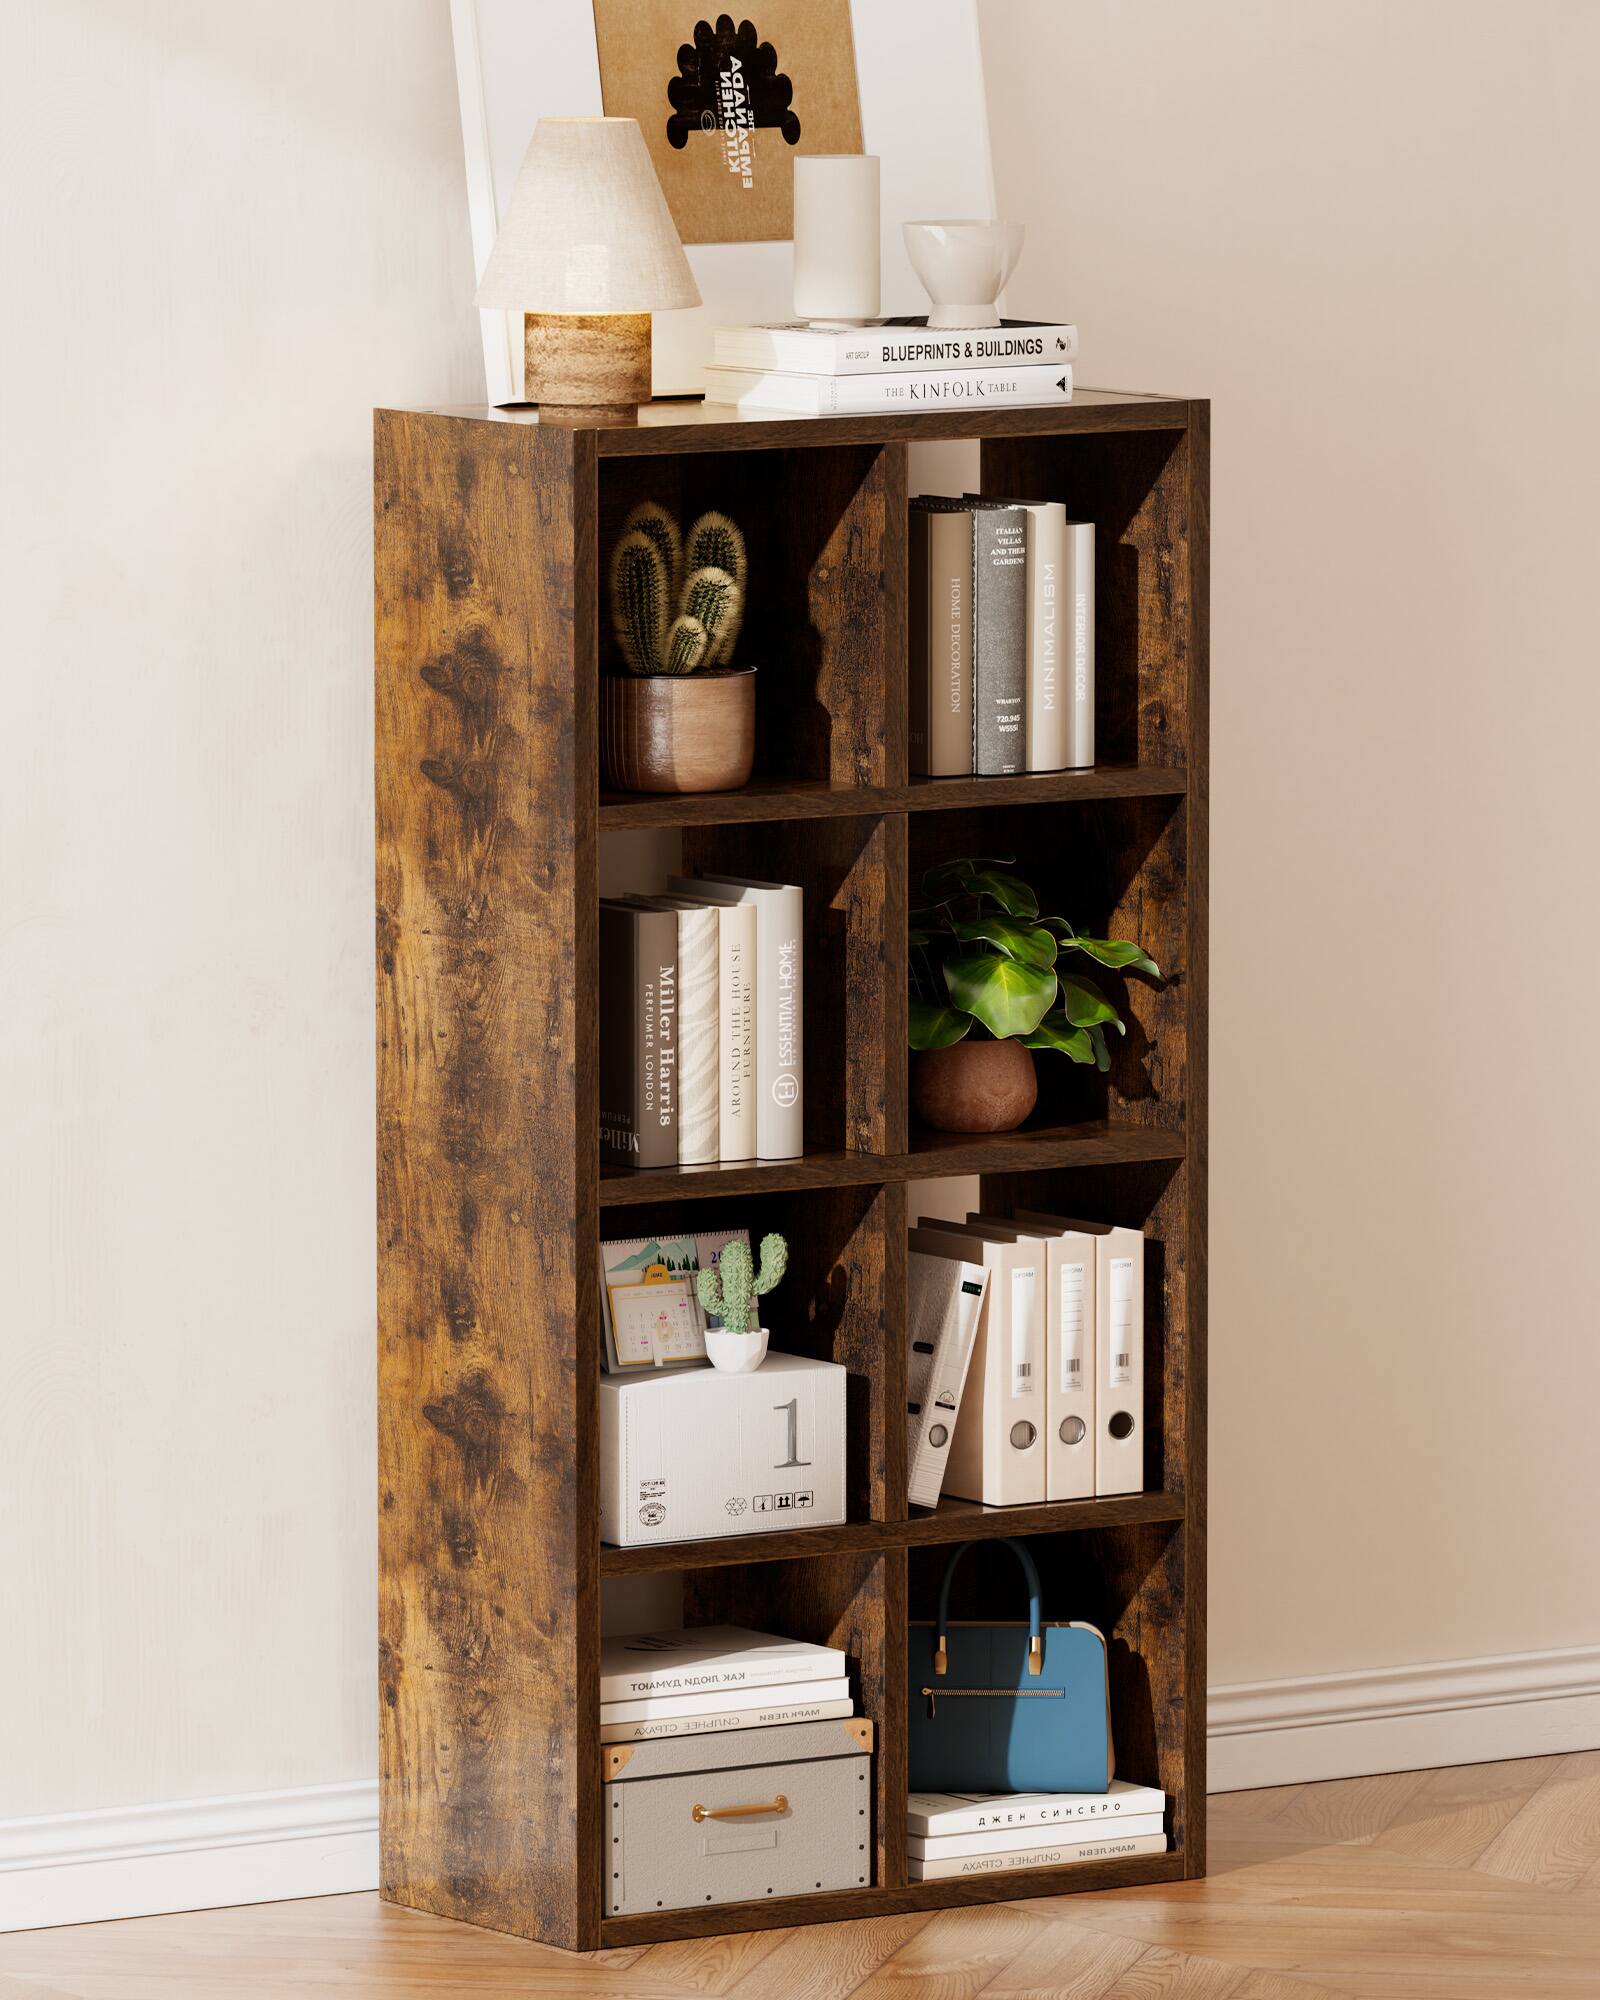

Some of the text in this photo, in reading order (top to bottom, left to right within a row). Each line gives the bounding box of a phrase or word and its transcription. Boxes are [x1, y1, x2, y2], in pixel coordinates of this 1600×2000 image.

[882, 338, 1043, 362] BLUEPRINTS & BUILDINGS
[885, 380, 1017, 400] THE KINFOLK TABLE
[990, 548, 1007, 556] AND
[993, 558, 1025, 566] GARDENS
[995, 527, 1024, 535] ITALIAN
[951, 578, 961, 713] HOME DECORATION
[1043, 563, 1055, 710] MINIMALISM
[1075, 593, 1086, 702] INTERIOR DECOR
[645, 983, 654, 1111] PERFUMER LONDON
[659, 965, 675, 1127] Miller Harris
[731, 943, 741, 1118] AROUND THE HOUSE
[743, 982, 751, 1078] FURNITURE
[778, 941, 793, 1067] ESSENTIAL HOME
[773, 1397, 812, 1469] 1
[978, 1803, 1121, 1826] ДЖЕН СИНСЕРО
